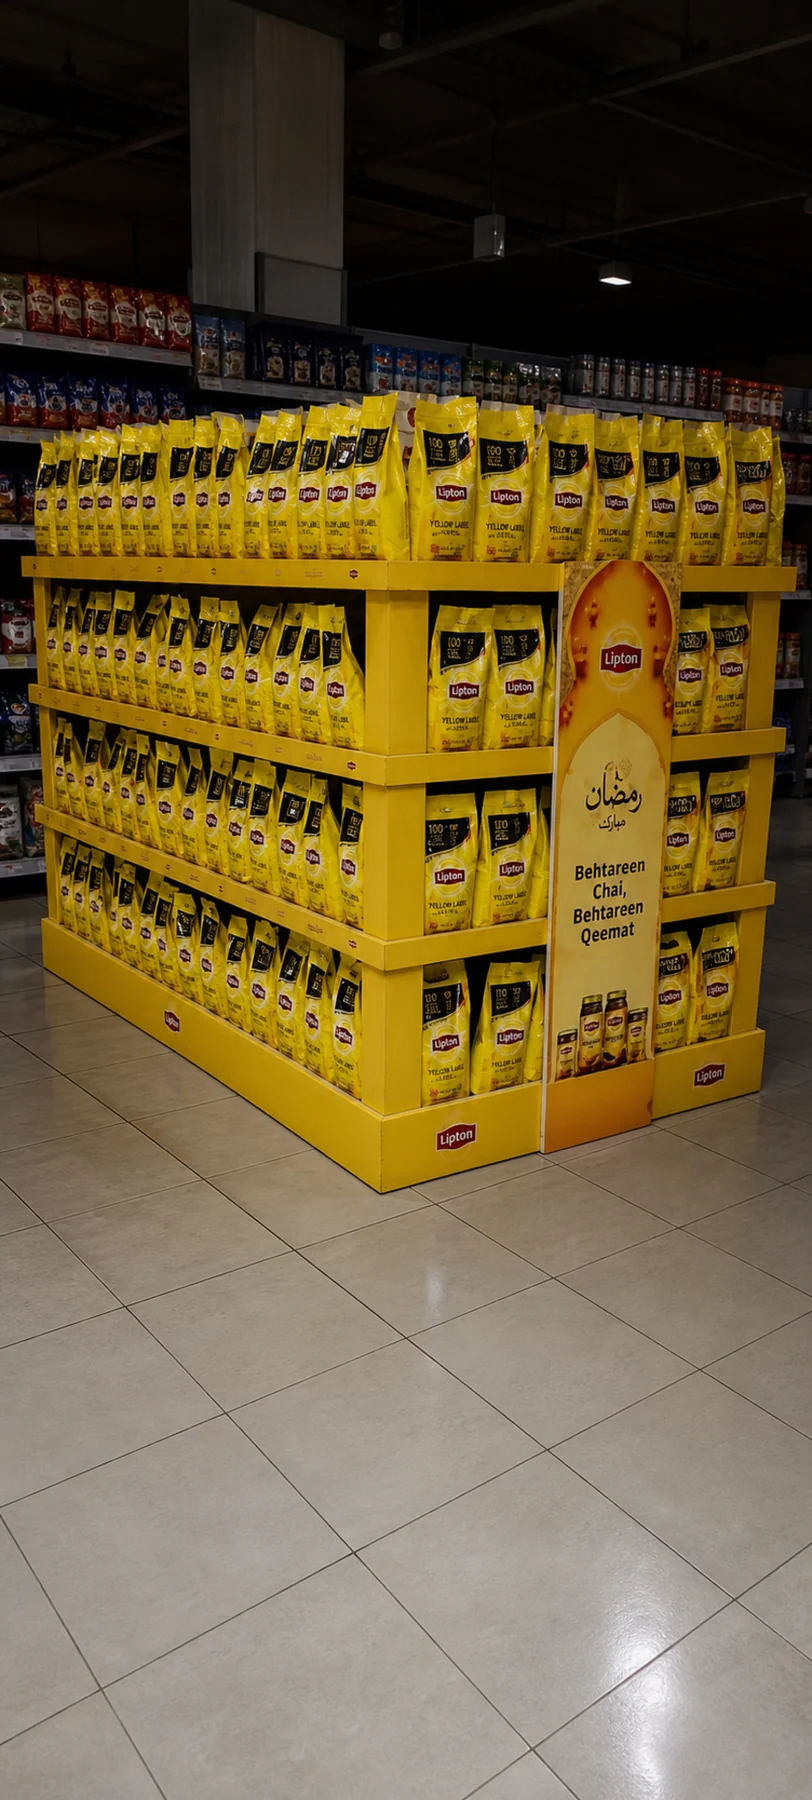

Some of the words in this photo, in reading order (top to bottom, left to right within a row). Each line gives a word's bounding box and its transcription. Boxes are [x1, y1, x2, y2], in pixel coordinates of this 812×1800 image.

[438, 487, 465, 500] Lipton
[493, 490, 520, 502] Lipton
[557, 495, 581, 506] Lipton
[605, 651, 638, 668] Lipton
[451, 685, 478, 697] Lipton
[507, 681, 533, 694] Lipton
[585, 766, 643, 813] رمضان
[598, 814, 626, 832] مبارك
[501, 863, 523, 875] Lipton
[575, 860, 646, 881] Behtareen
[436, 872, 463, 882] Lipton
[592, 880, 627, 900] Chai,
[573, 901, 644, 924] Behtareen
[581, 921, 635, 947] Qeemat
[499, 1031, 523, 1043] Lipton
[434, 1038, 458, 1051] Lipton
[697, 1067, 723, 1083] Lipton
[440, 1129, 473, 1147] Lipton
